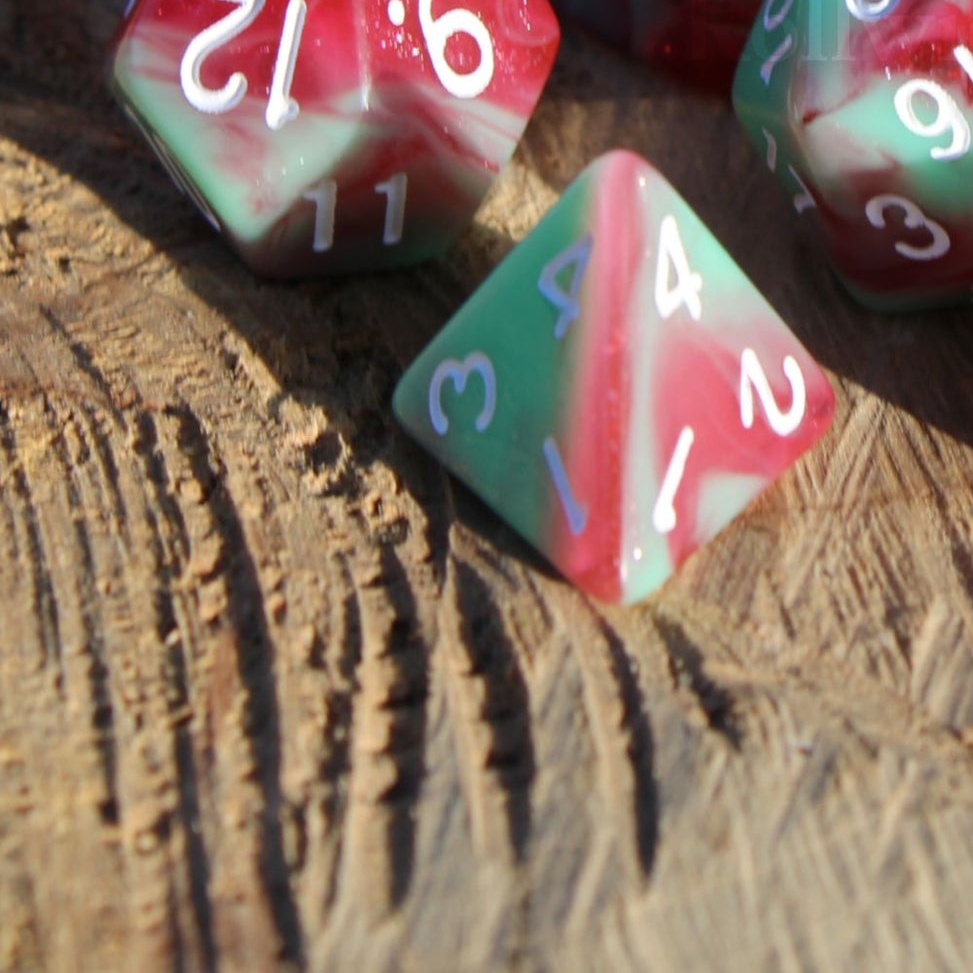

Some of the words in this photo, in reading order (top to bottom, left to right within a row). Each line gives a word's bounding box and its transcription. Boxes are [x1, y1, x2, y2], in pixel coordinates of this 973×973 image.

[303, 172, 407, 251] 11
[865, 195, 950, 259] 3
[537, 234, 594, 339] 4
[655, 216, 702, 321] 4
[429, 352, 495, 435] 3
[740, 348, 805, 436] 2
[653, 426, 693, 533] 1
